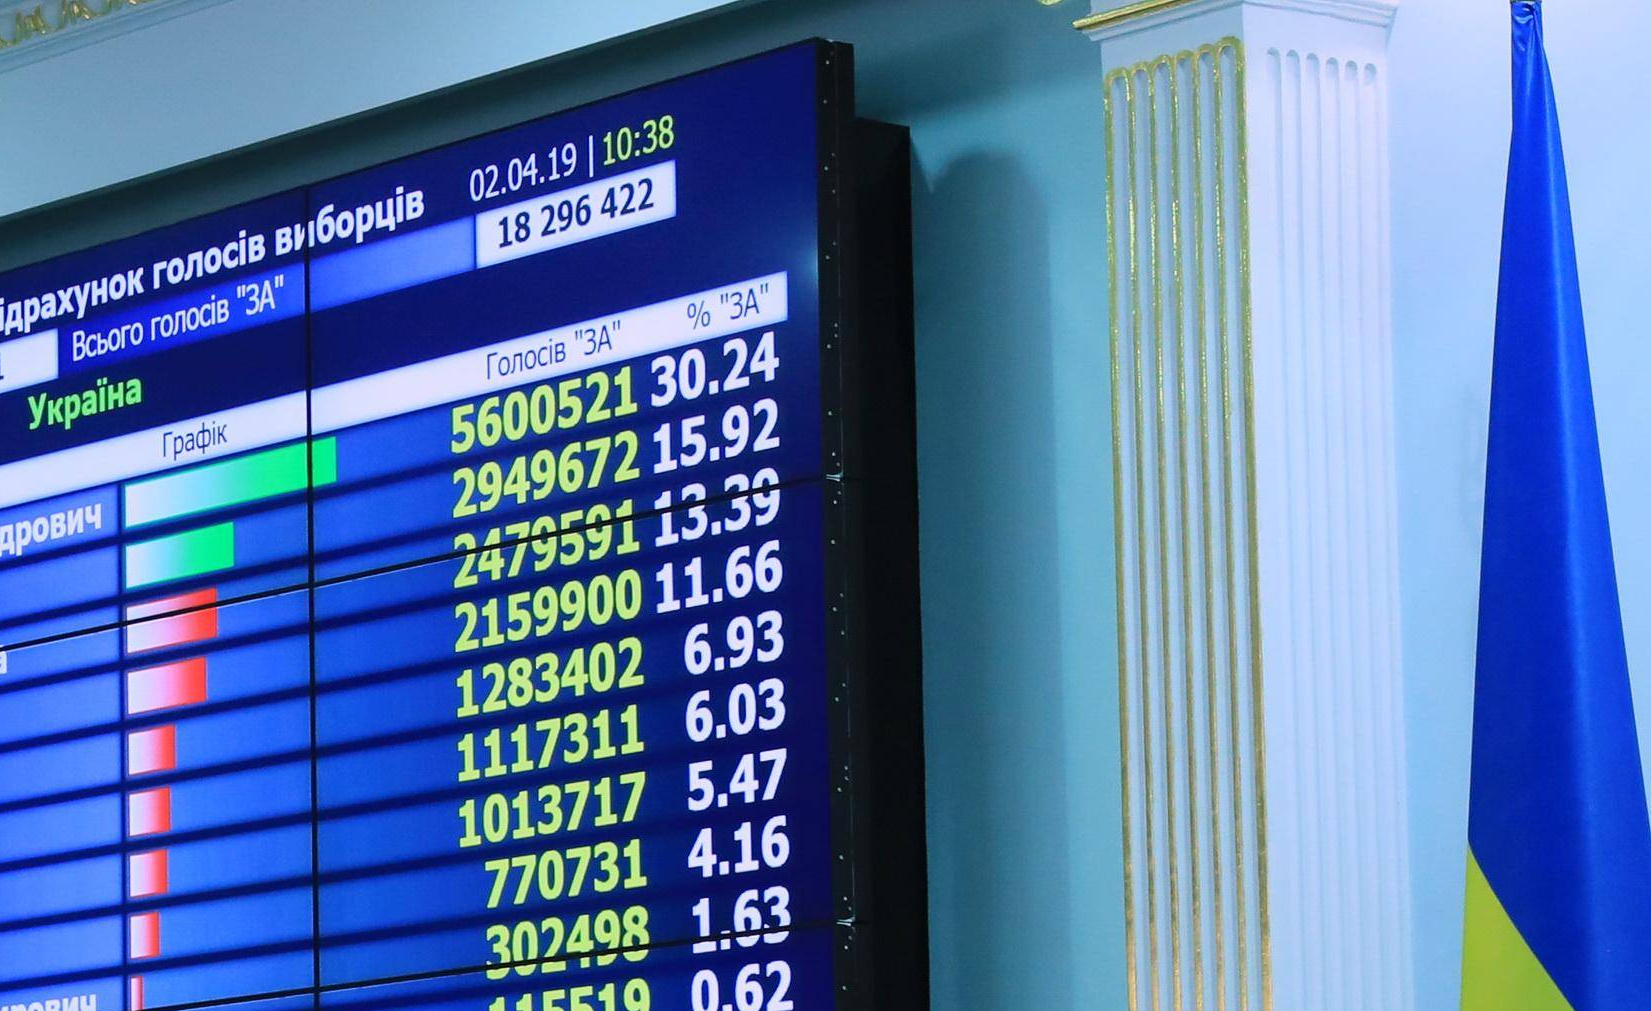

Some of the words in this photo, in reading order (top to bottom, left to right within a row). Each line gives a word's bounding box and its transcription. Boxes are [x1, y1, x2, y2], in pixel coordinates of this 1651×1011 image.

[469, 142, 577, 202] 02.04.19
[602, 114, 674, 165] 10:38
[152, 229, 266, 289] голосів
[274, 185, 424, 256] виборців
[498, 210, 531, 248] 18
[540, 193, 591, 237] 296
[600, 177, 654, 219] 422
[72, 321, 143, 361] Всього
[150, 294, 229, 341] голосів
[486, 338, 566, 380] Голосів
[686, 299, 711, 329] %
[27, 376, 142, 430] Україна
[450, 365, 638, 453] 5600521
[650, 330, 779, 407] 30.24
[162, 420, 227, 461] Графік
[452, 429, 640, 518] 2949672
[652, 397, 780, 473] 15.92
[453, 498, 639, 588] 2479591
[654, 468, 780, 547] 13.39
[454, 568, 642, 652] 2159900
[655, 538, 783, 613] 11.66
[456, 636, 644, 717] 1283402
[683, 609, 784, 675] 6.93
[457, 703, 644, 782] 1117311
[685, 677, 785, 742] 6.03
[458, 770, 646, 847] 1013717
[687, 747, 787, 811] 5.47
[484, 838, 647, 908] 770731
[687, 814, 789, 878] 4.16
[485, 905, 649, 980] 302498
[692, 885, 791, 954] 1.63
